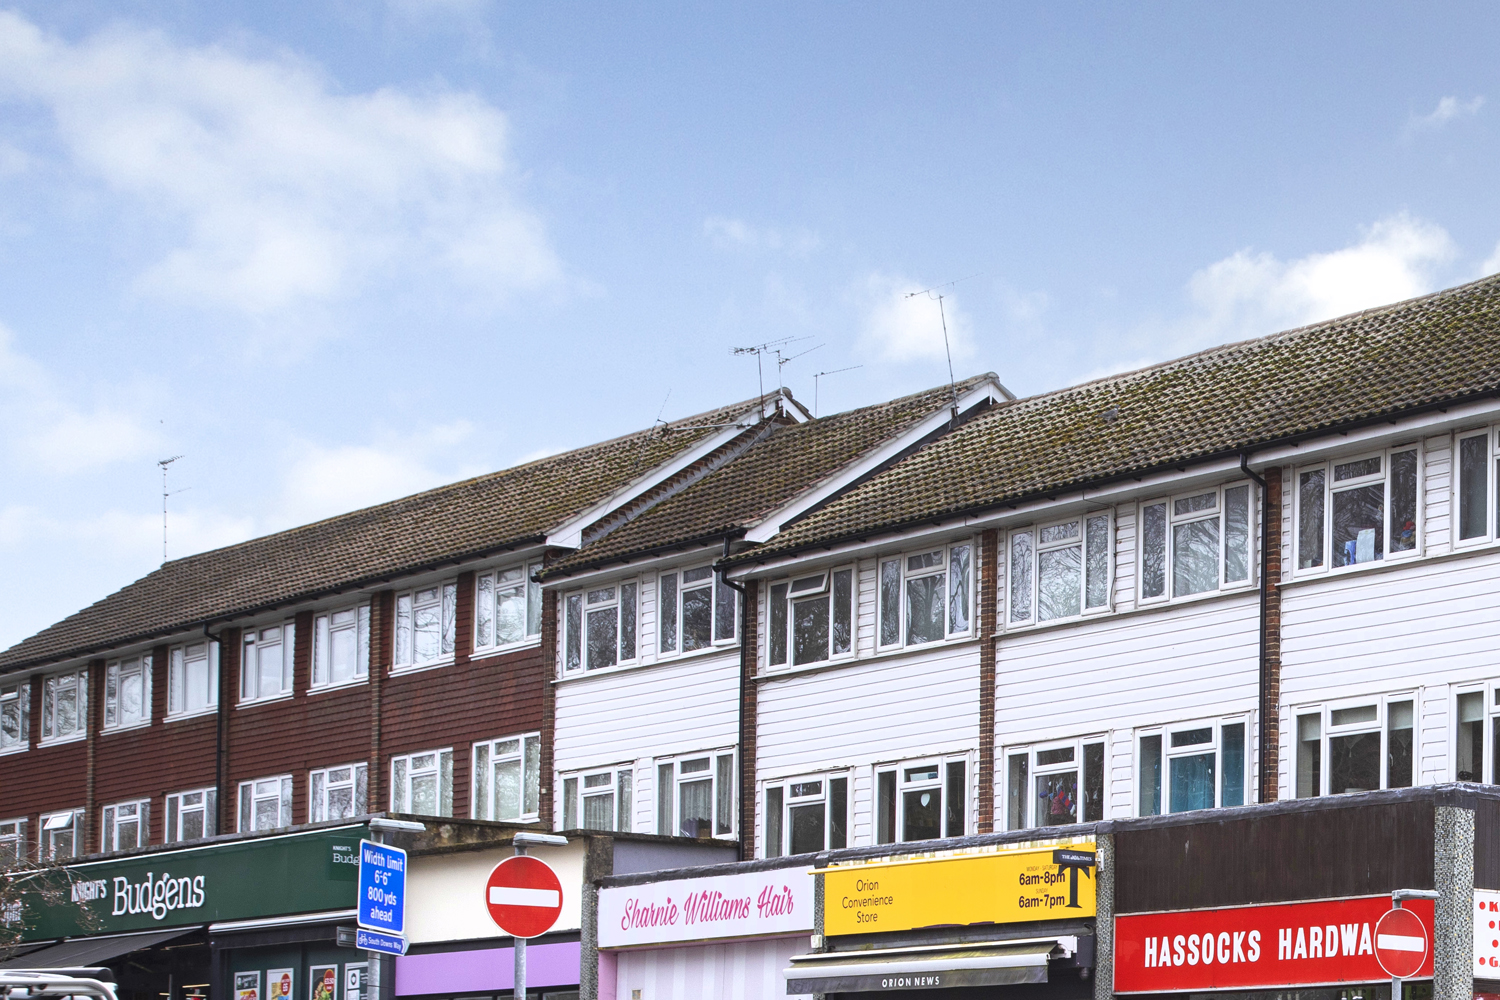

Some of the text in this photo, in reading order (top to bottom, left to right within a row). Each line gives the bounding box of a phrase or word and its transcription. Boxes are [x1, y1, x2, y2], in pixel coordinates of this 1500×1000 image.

[332, 852, 360, 866] Budg
[364, 848, 403, 872] Width limit
[856, 879, 879, 892] Orion
[1019, 871, 1066, 886] 6am-8pm
[112, 872, 205, 920] Budgens
[368, 886, 396, 906] 800 yds
[842, 894, 893, 909] Convenience
[1018, 894, 1065, 909] 6am-7pm
[370, 906, 392, 922] ahead
[621, 885, 794, 930] Sharnie Williams Hair
[857, 911, 878, 923] Store
[368, 937, 402, 951] South Downs Way
[1144, 922, 1374, 968] HASSOCKS HARDWA
[882, 976, 940, 988] ORION NEWS
